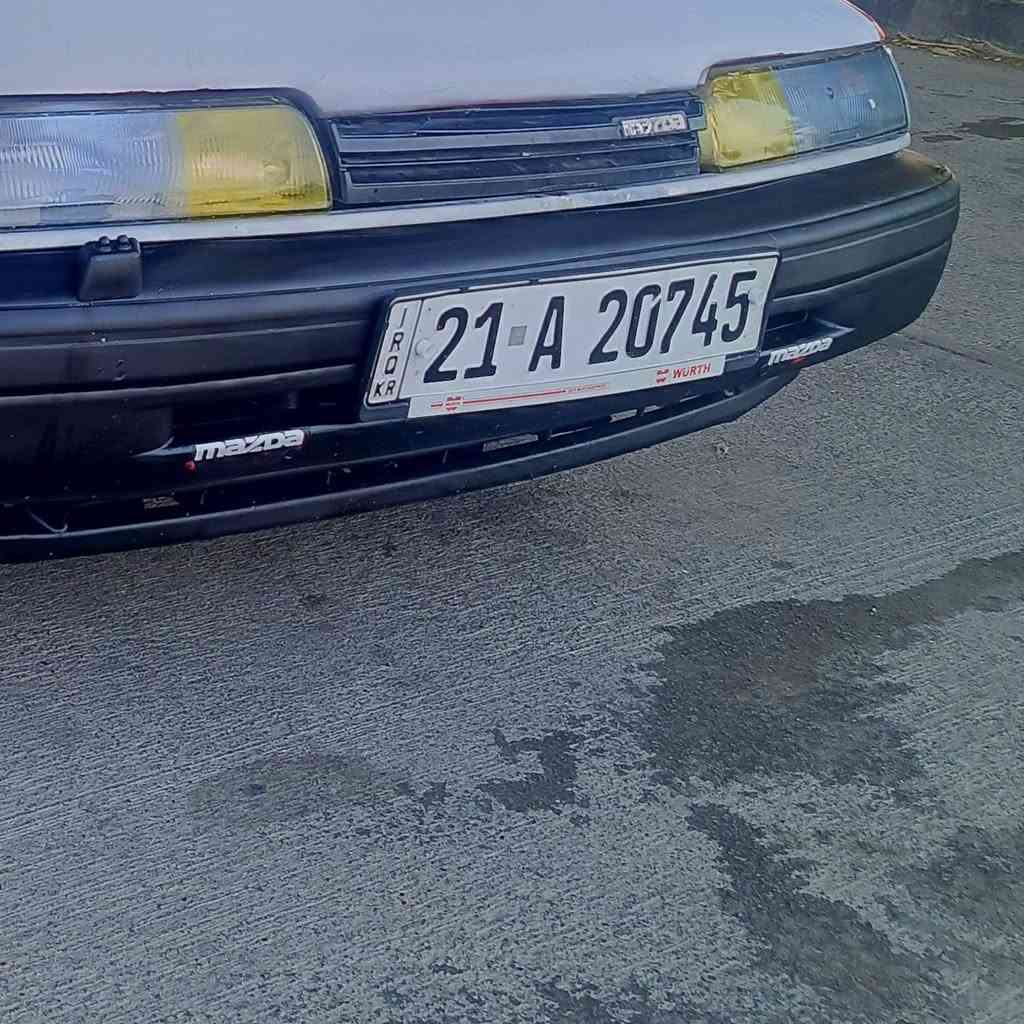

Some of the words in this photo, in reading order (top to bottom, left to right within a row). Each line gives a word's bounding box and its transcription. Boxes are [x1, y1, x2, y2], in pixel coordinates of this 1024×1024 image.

[422, 300, 504, 385] 21
[527, 294, 567, 373] A
[587, 269, 759, 366] 20745
[373, 379, 397, 397] KR
